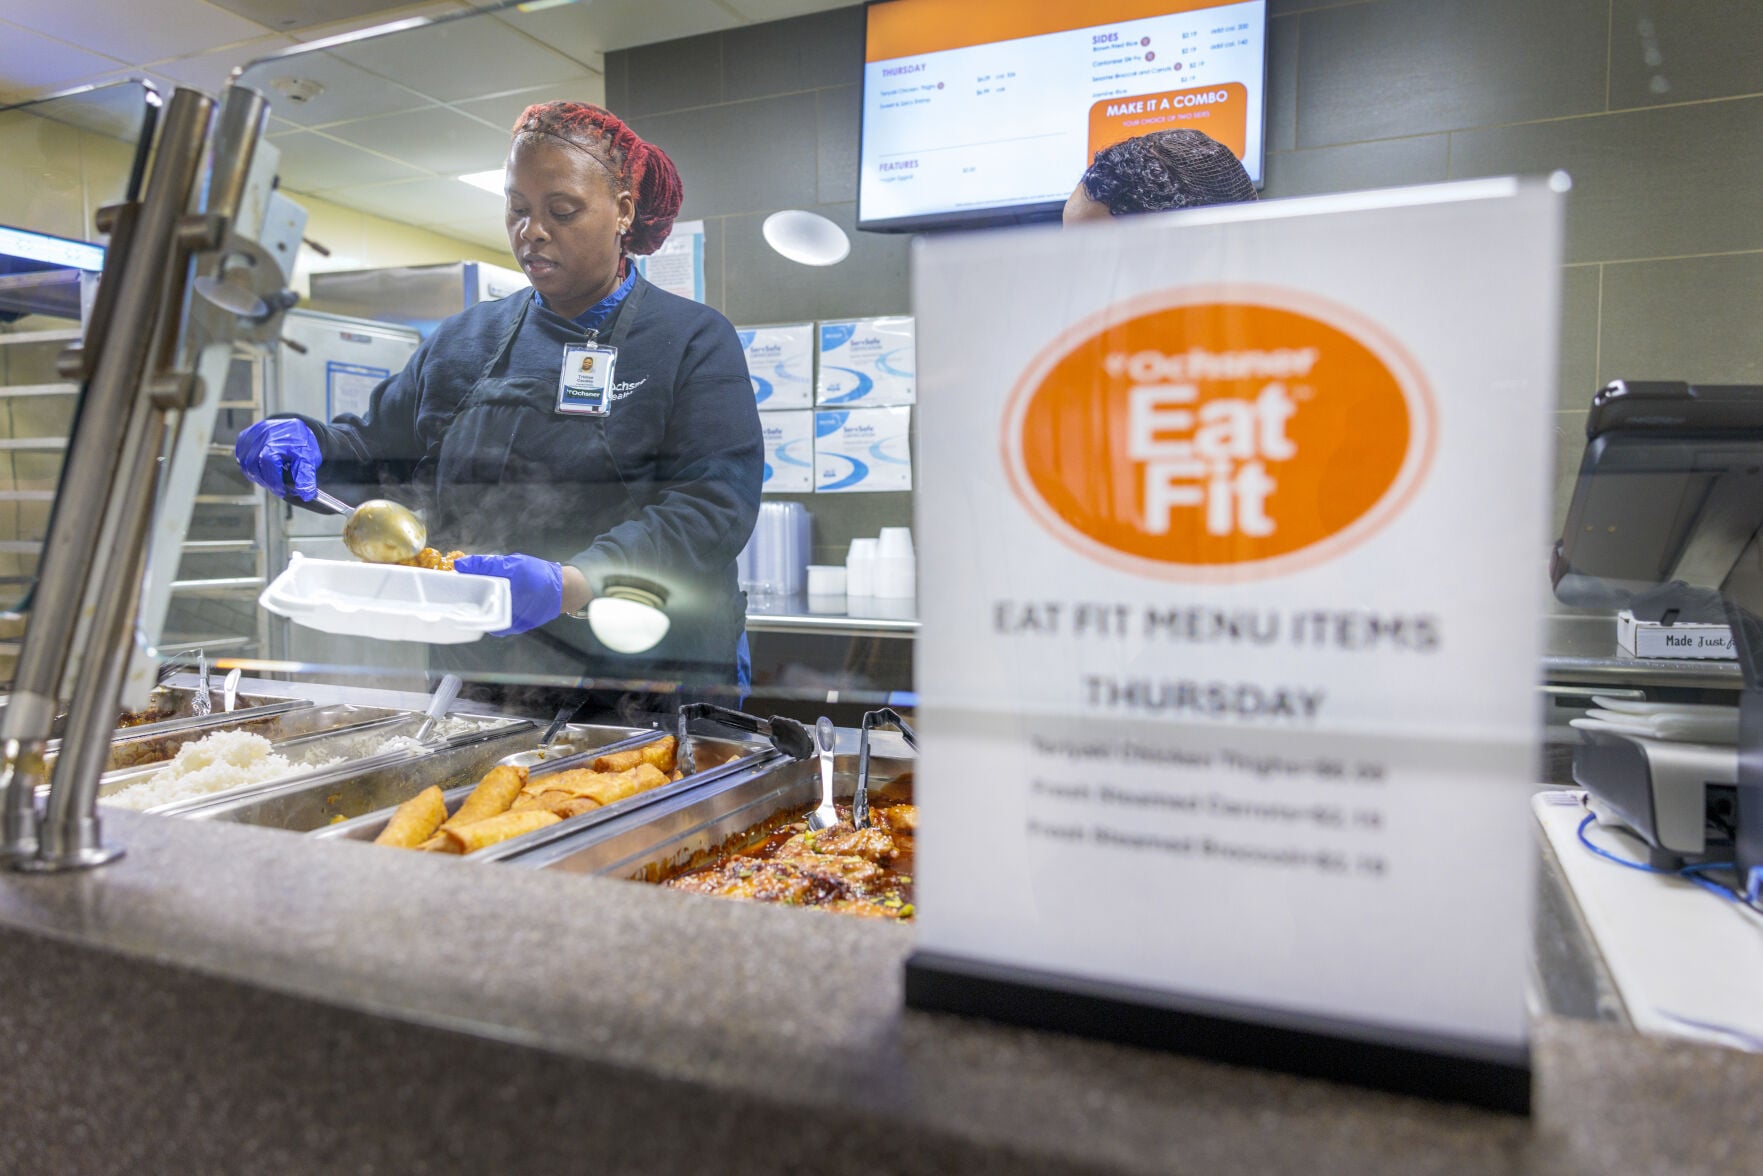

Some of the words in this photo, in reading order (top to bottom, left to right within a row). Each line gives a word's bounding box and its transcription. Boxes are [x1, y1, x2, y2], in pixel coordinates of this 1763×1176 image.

[1093, 32, 1119, 44] SIDES
[882, 63, 927, 77] THURSDAY
[1106, 101, 1144, 117] MAKE
[1146, 99, 1157, 112] IT
[1160, 98, 1170, 110] A
[1173, 90, 1228, 108] COMBO
[880, 160, 919, 172] FEATURES
[1130, 346, 1318, 382] Ochsner
[571, 390, 601, 398] Ochsner
[1129, 381, 1297, 462] Eat
[1142, 459, 1277, 538] Fit
[993, 600, 1063, 637] EAT
[1072, 603, 1130, 640] FIT
[1142, 606, 1281, 647] MENU
[1291, 610, 1443, 654] ITEMS
[1666, 635, 1692, 646] Made
[1698, 636, 1726, 648] Just
[1083, 674, 1327, 720] THURSDAY
